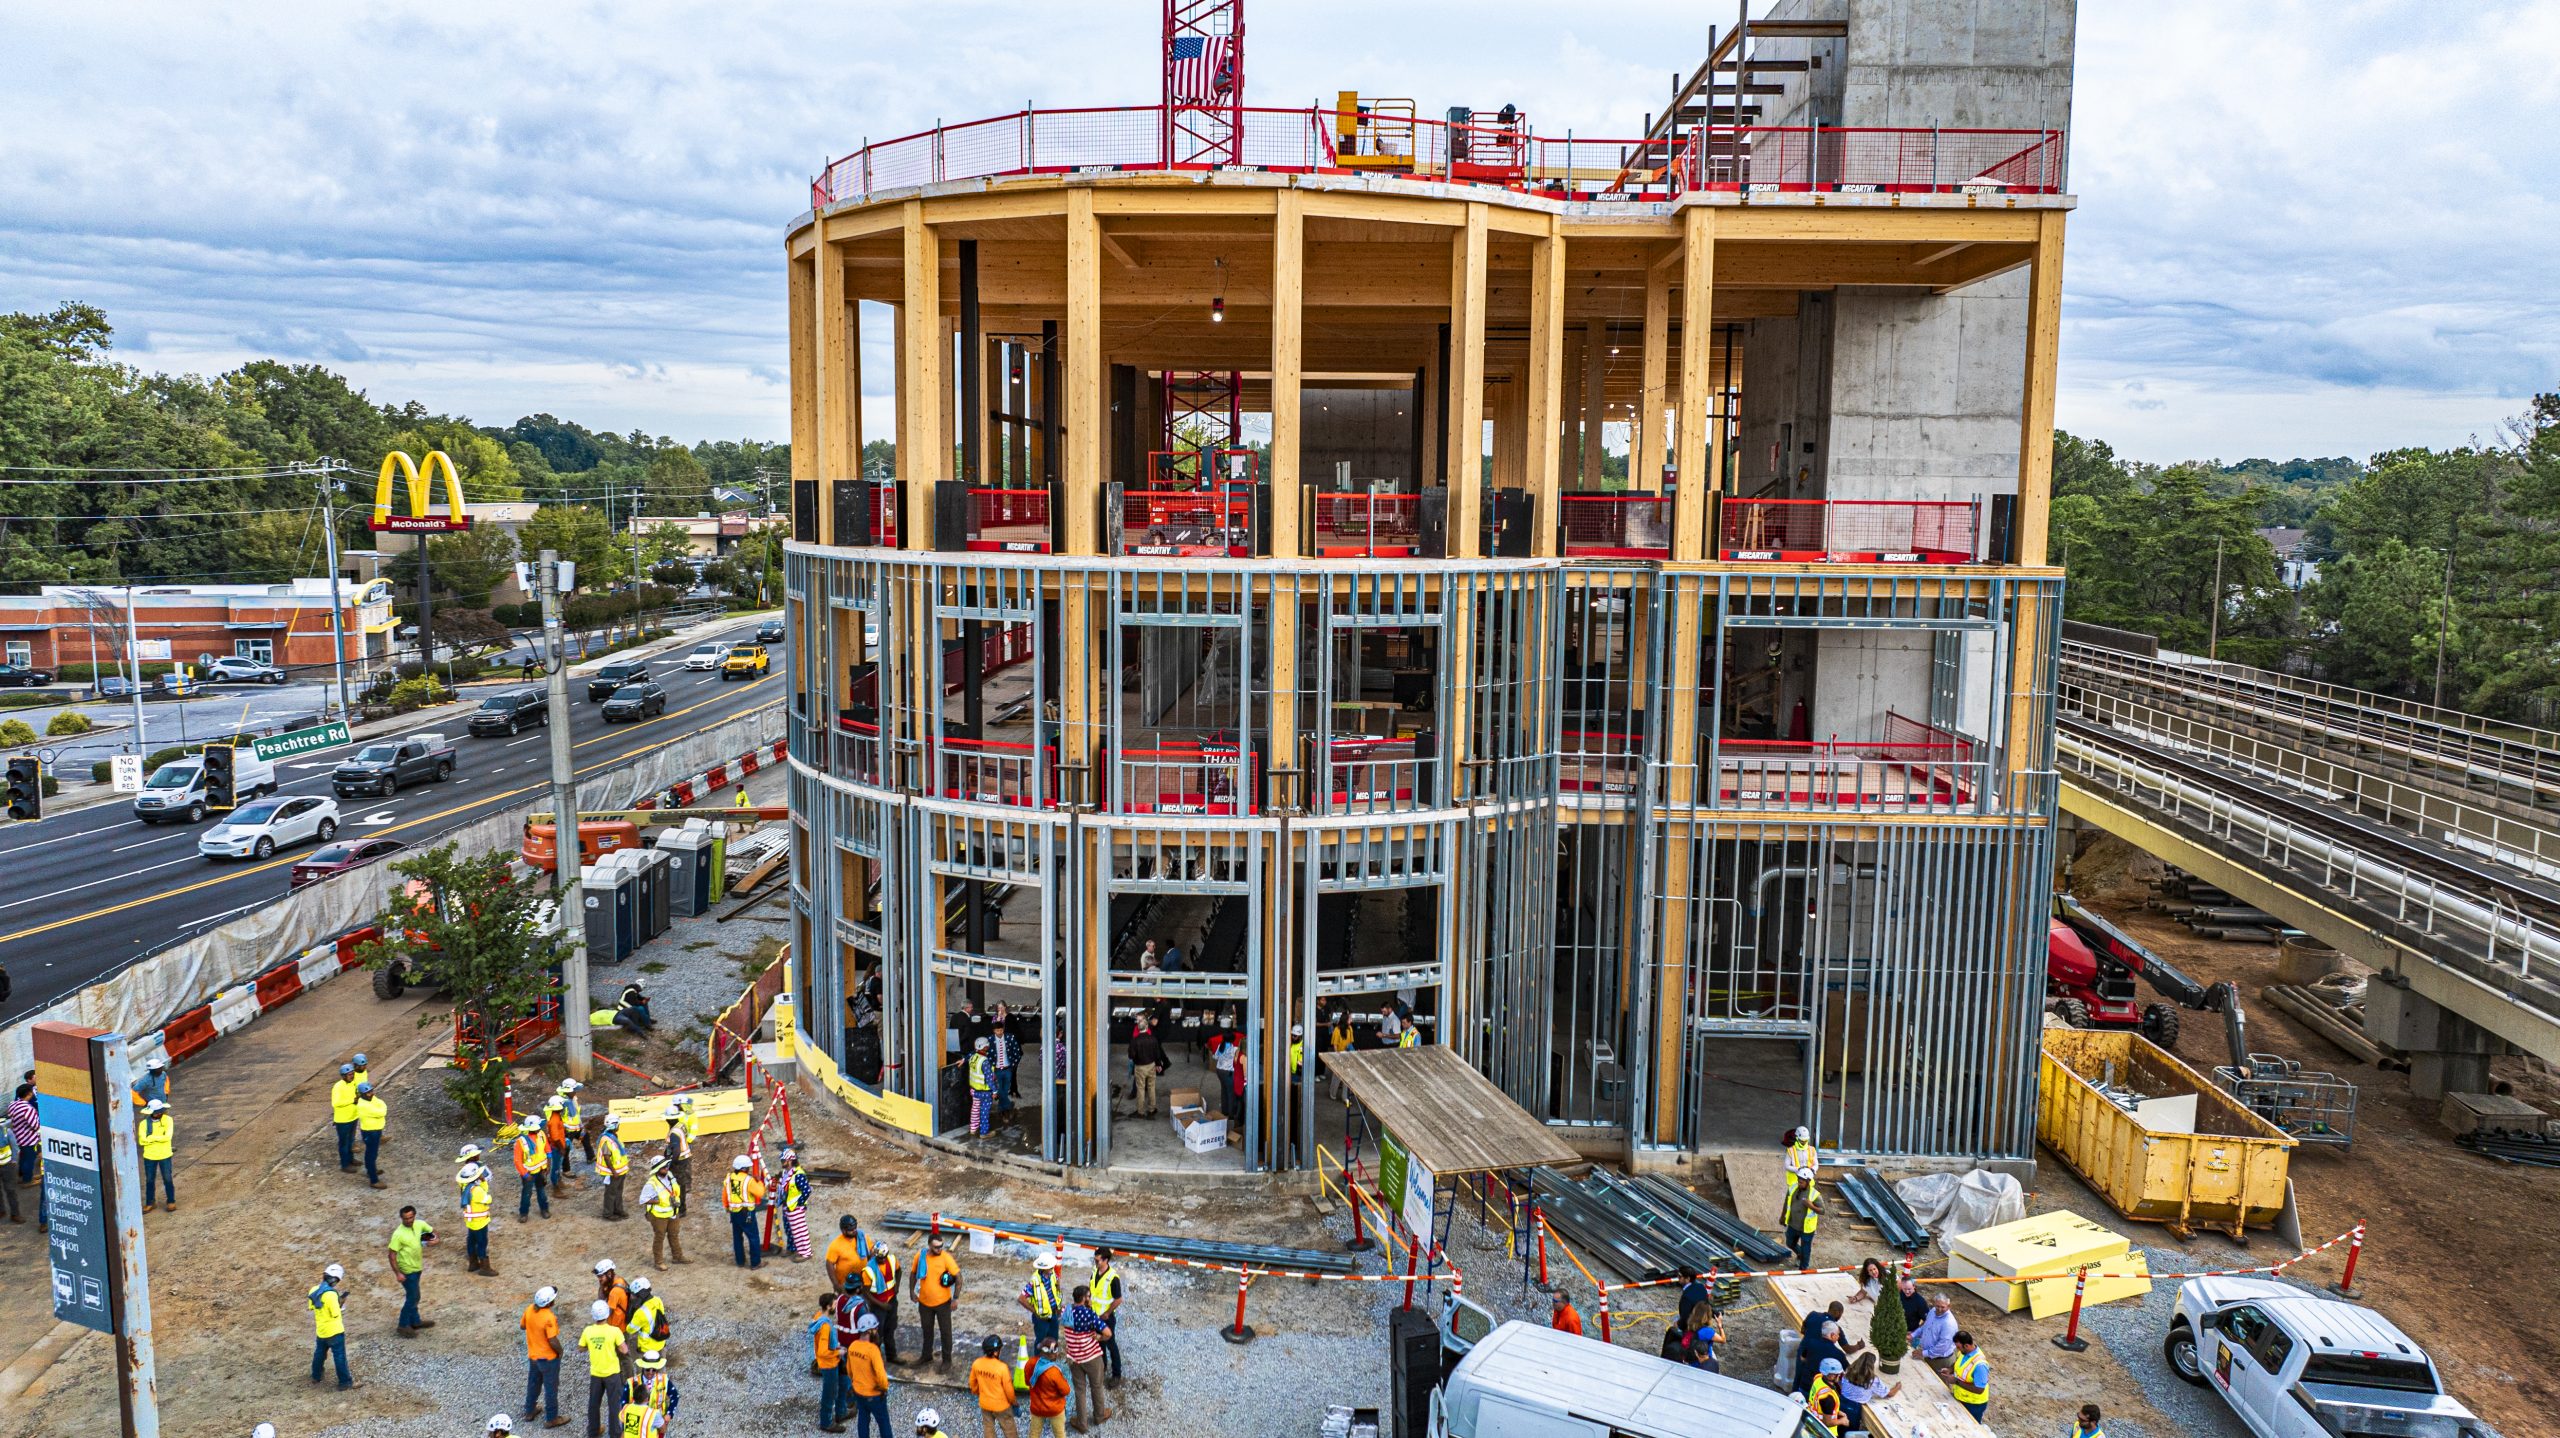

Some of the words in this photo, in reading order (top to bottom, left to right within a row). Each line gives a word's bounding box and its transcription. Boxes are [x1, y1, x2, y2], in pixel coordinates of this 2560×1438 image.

[257, 734, 325, 756] Peachtree
[328, 727, 346, 741] Rd
[48, 1138, 93, 1161] marta
[1200, 1135, 1225, 1145] JERZEES
[47, 1172, 94, 1194] Brookhaven-
[48, 1188, 93, 1209] Oglethorpe
[49, 1203, 89, 1225] University
[50, 1219, 78, 1236] Transit
[51, 1234, 79, 1252] Station
